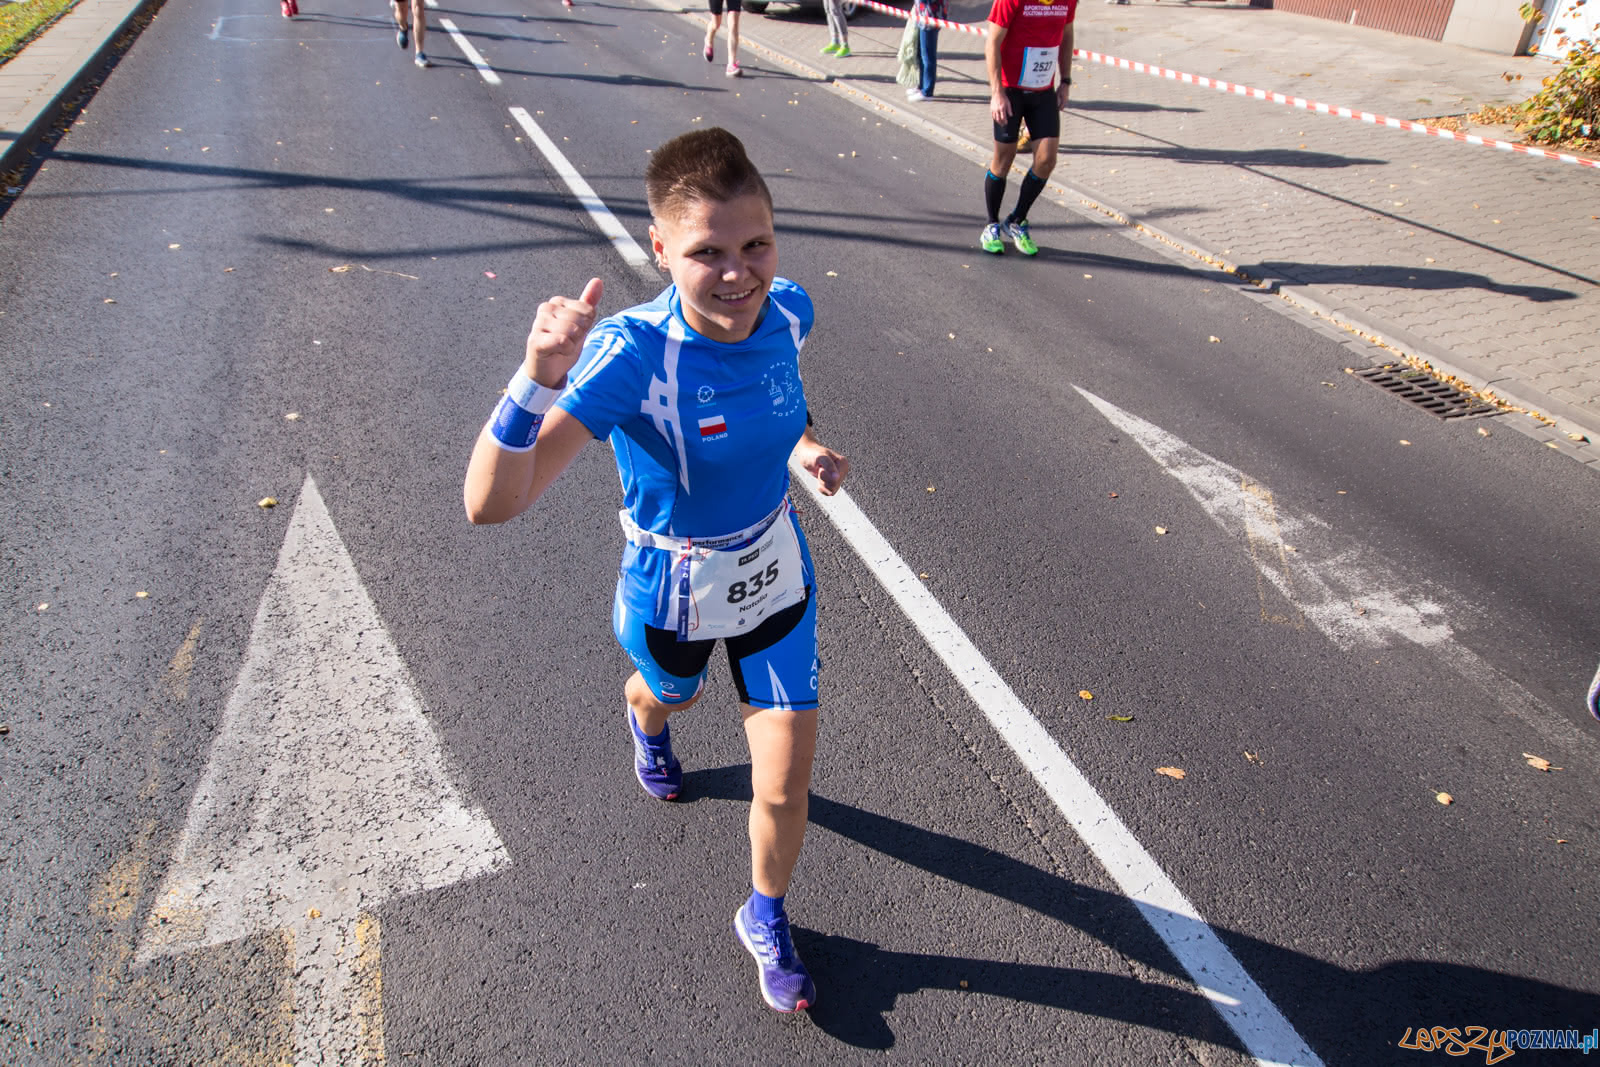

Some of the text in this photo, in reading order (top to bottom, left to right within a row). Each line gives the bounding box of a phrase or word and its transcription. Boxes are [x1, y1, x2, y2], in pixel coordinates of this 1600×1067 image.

[1032, 60, 1053, 72] 2527
[702, 432, 728, 443] POLAND
[691, 533, 744, 547] performance
[726, 558, 779, 604] 835
[739, 593, 768, 613] Natalia
